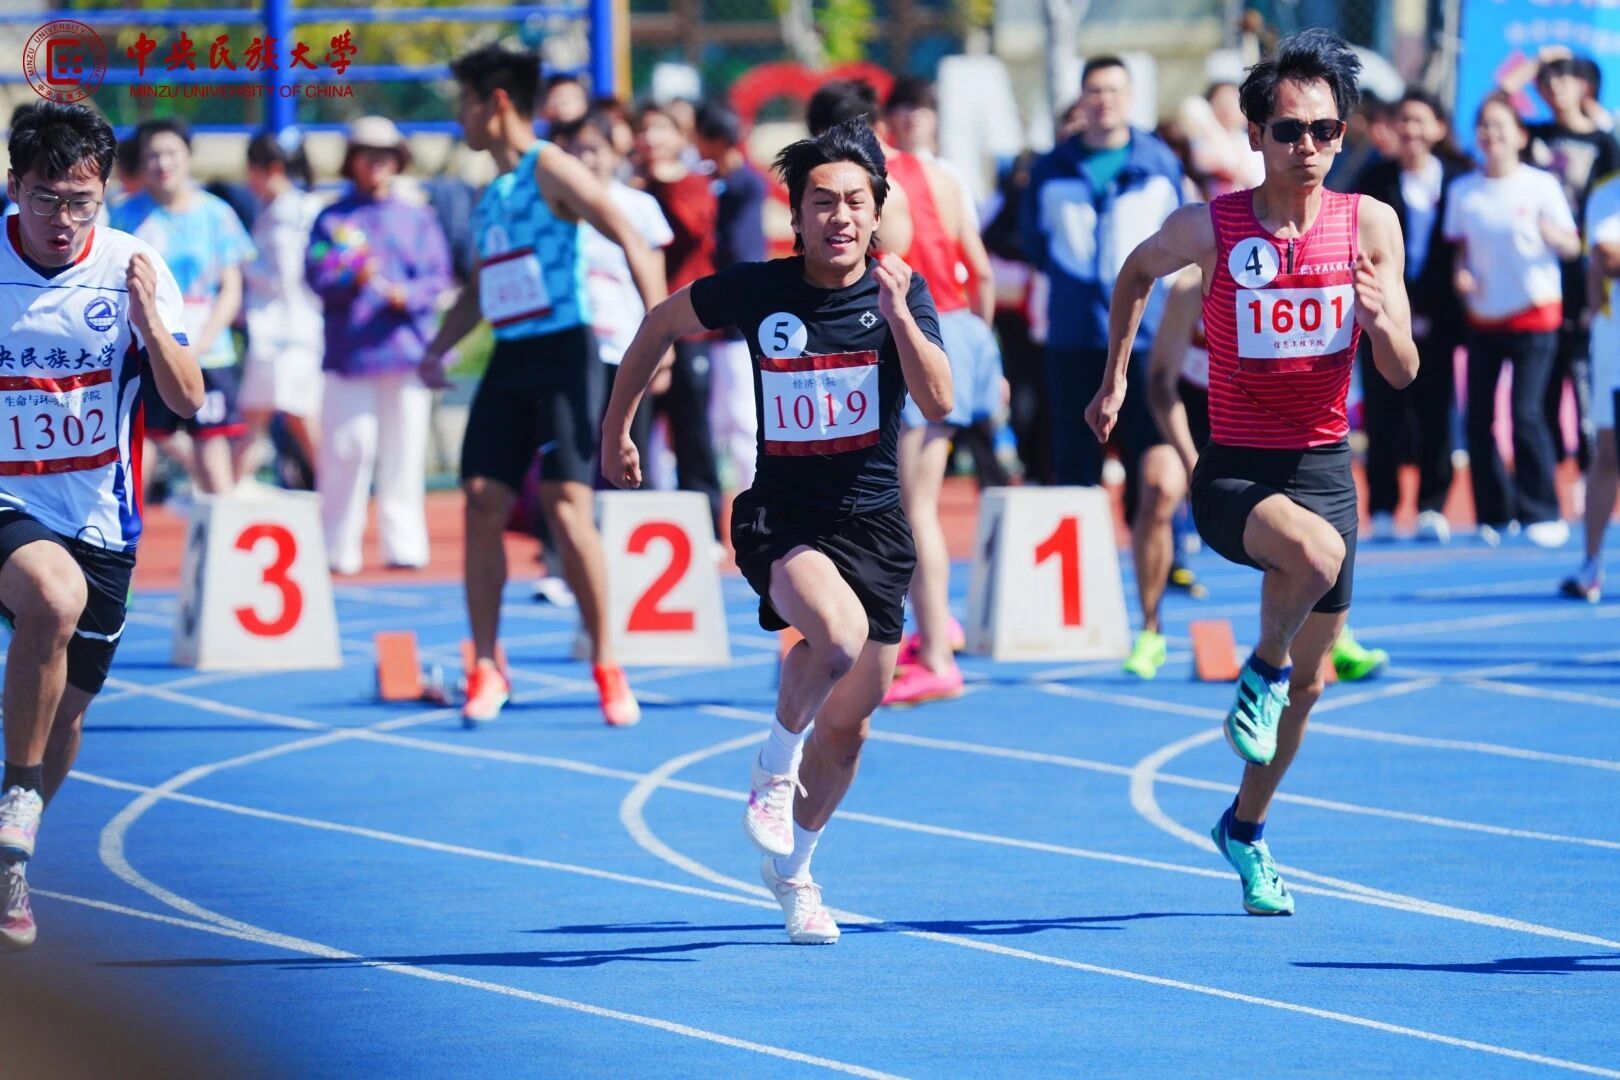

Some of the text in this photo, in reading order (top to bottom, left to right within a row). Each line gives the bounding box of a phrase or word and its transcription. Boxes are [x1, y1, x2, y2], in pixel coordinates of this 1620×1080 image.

[1245, 246, 1263, 276] 4
[1248, 296, 1343, 334] 1601
[773, 321, 789, 352] 5
[9, 408, 106, 450] 1302
[774, 390, 867, 429] 1019
[234, 523, 303, 637] 3
[626, 521, 694, 632] 2
[1035, 517, 1081, 626] 1
